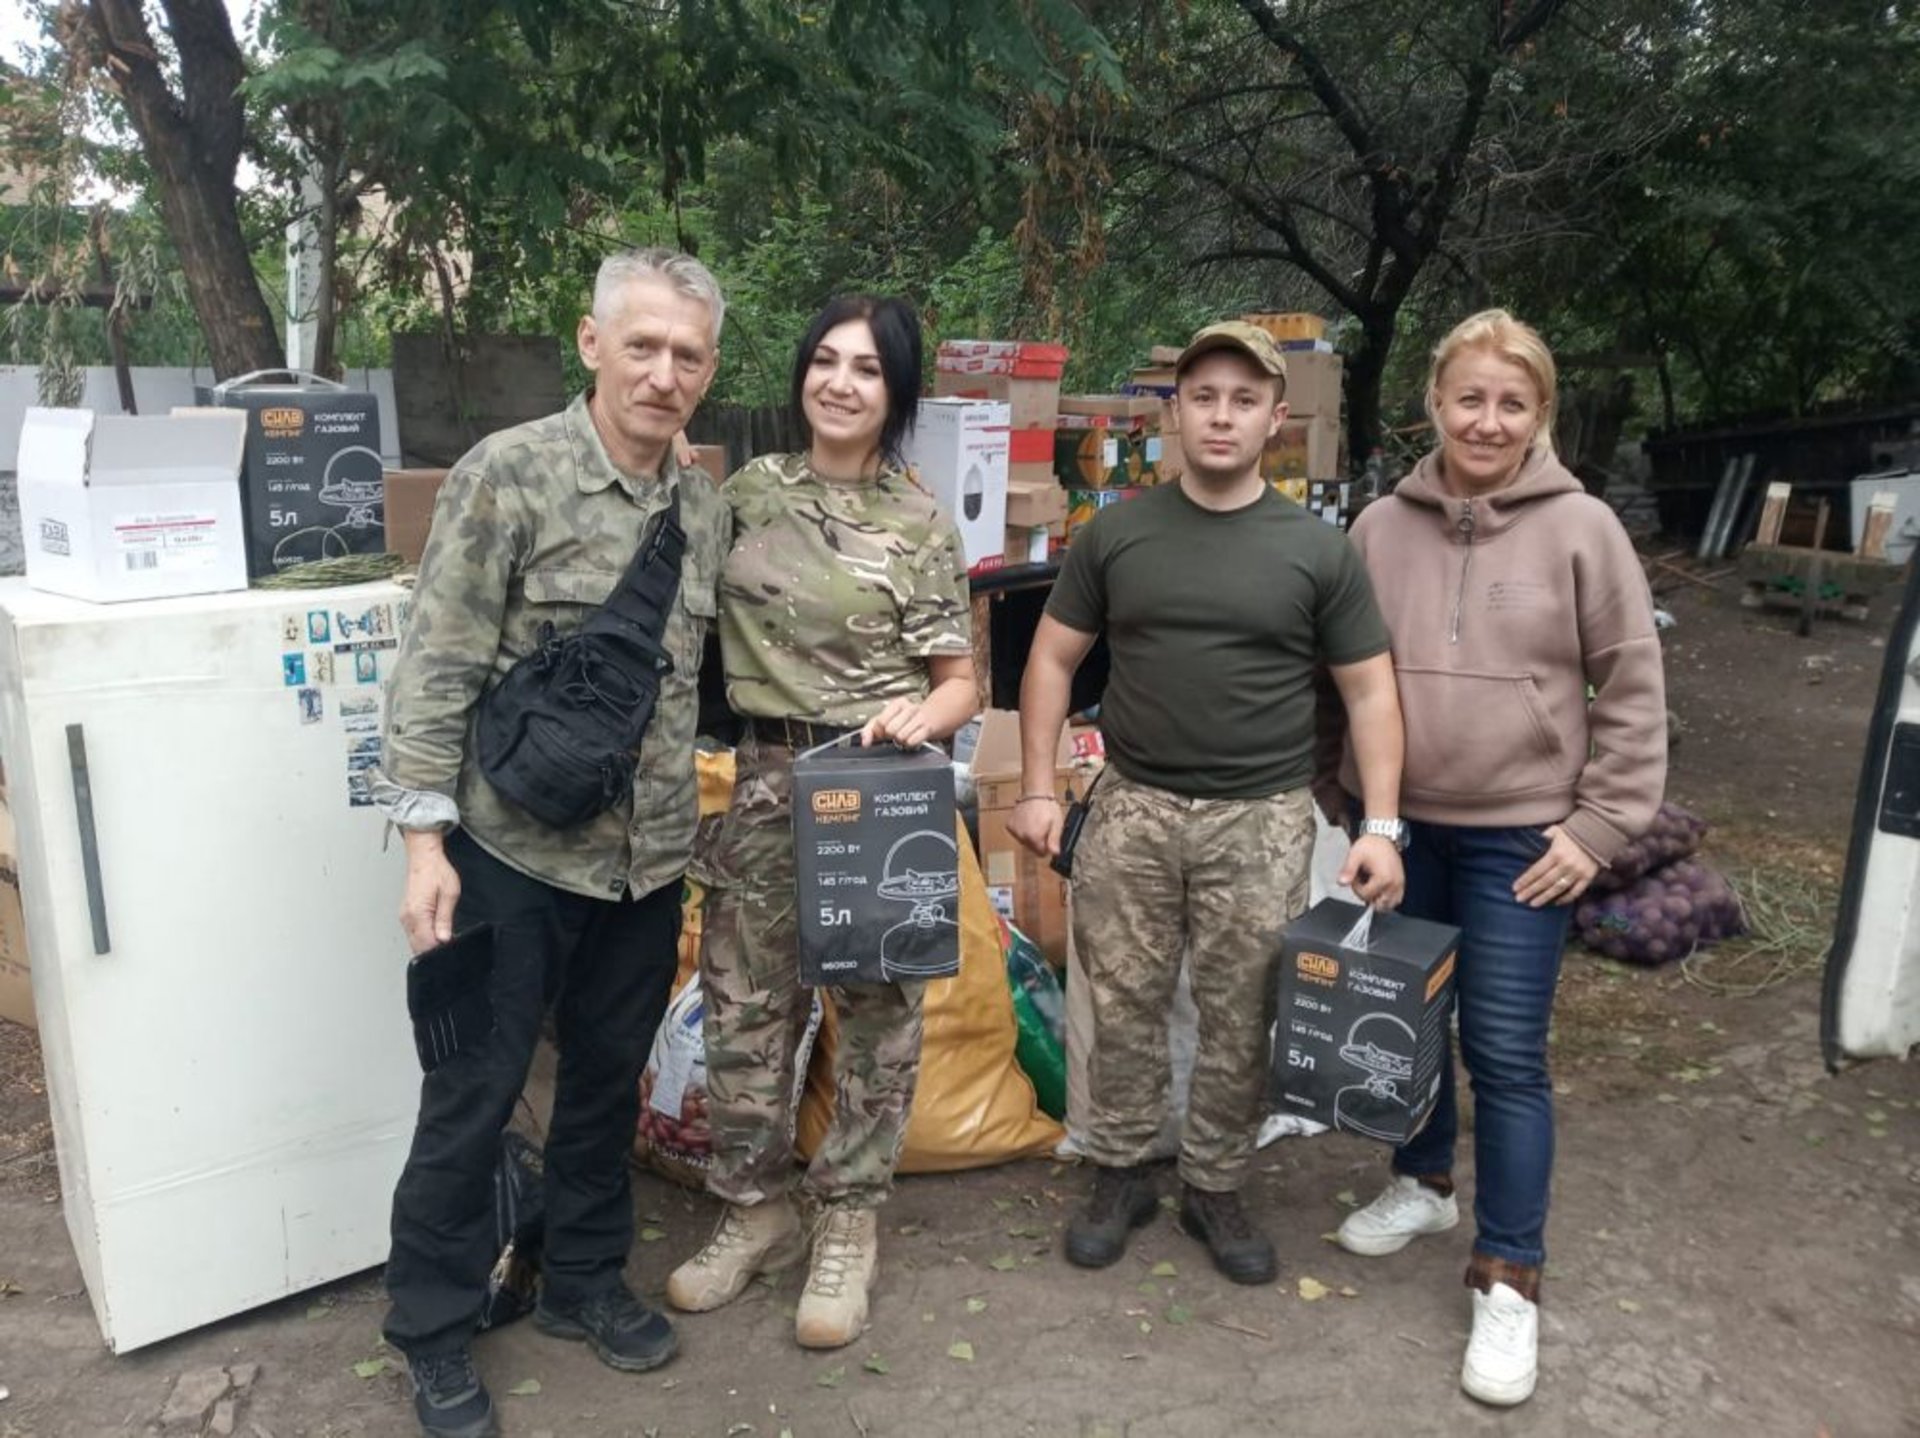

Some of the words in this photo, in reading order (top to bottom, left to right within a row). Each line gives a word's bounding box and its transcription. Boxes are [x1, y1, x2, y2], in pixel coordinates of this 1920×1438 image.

[314, 423, 360, 433] ГАЗОВИЙ
[873, 791, 936, 803] КОМПЛЕКТ
[875, 804, 928, 817] ГАЗОВИЙ
[817, 845, 845, 855] 2200
